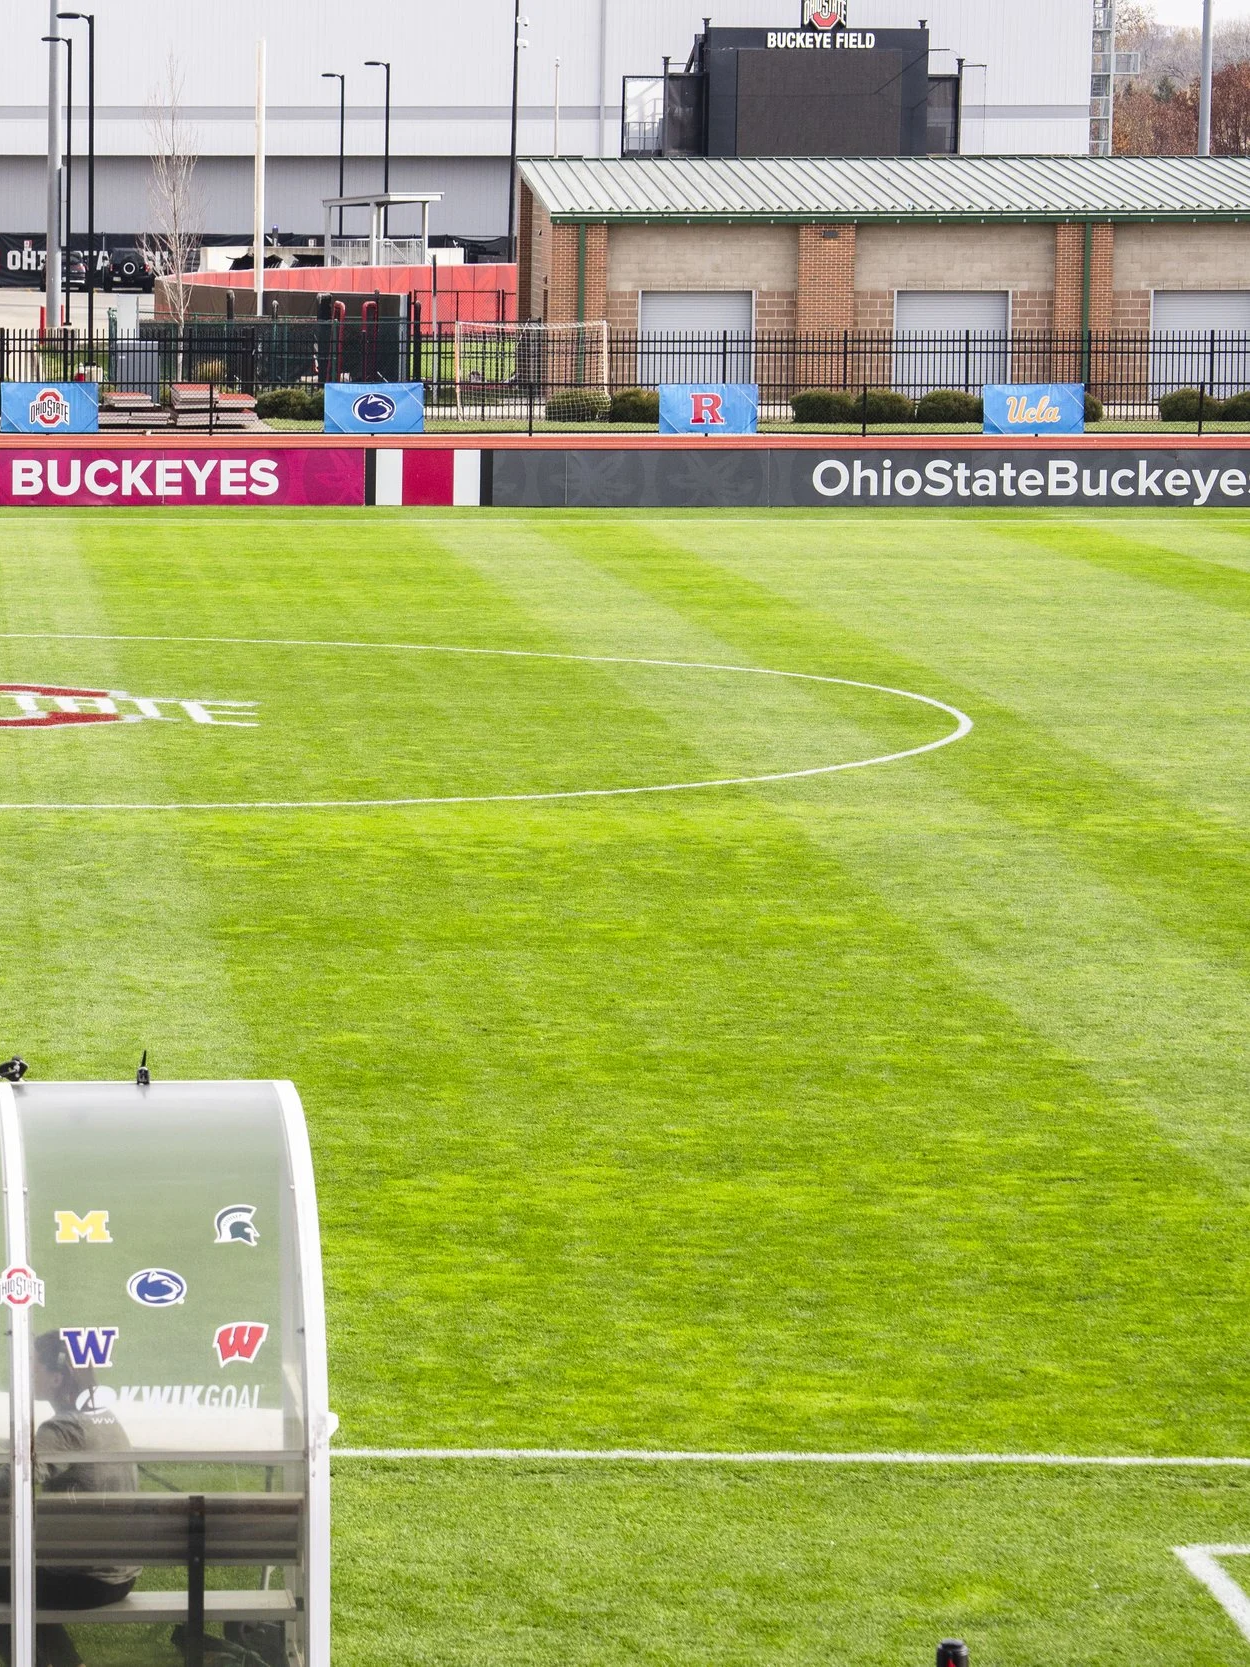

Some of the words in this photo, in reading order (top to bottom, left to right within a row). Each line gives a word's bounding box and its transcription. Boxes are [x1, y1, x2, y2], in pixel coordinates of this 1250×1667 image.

[767, 32, 831, 49] BUCKEYE
[835, 32, 876, 49] FIELD
[6, 249, 48, 271] OHI
[690, 392, 725, 424] R
[12, 458, 279, 497] BUCKEYES
[812, 459, 1250, 507] OhioStateBuckeye
[55, 1211, 111, 1242] M
[62, 1329, 117, 1367] W
[215, 1324, 267, 1364] W
